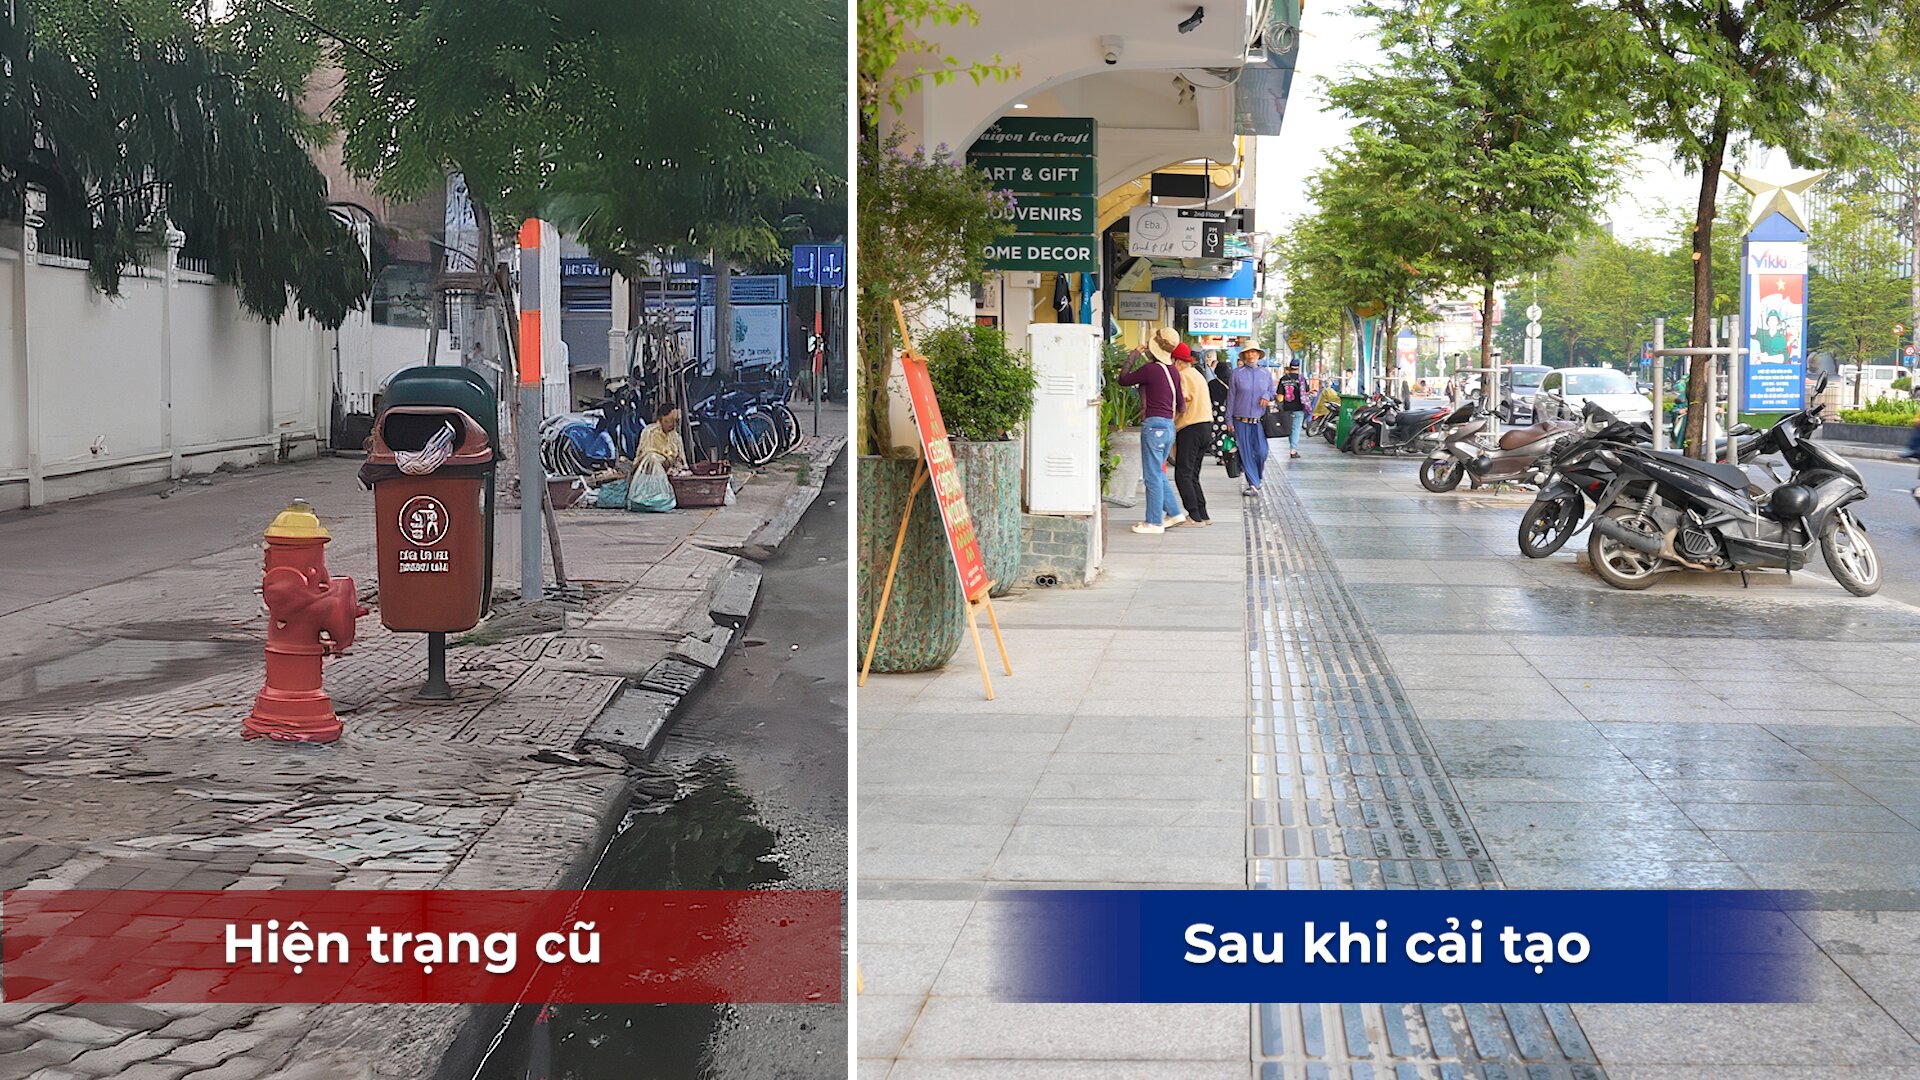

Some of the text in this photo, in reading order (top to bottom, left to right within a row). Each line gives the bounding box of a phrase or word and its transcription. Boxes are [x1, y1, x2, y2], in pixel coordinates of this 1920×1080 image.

[979, 131, 1090, 145] aigon Eco Craft
[983, 167, 1080, 182] ART & GIFT
[984, 207, 1083, 222] OUVENIRS
[982, 246, 1091, 261] OME DECOR
[1751, 247, 1788, 269] Vikki
[1193, 308, 1213, 316] GS25
[1193, 318, 1248, 330] STORE 24H
